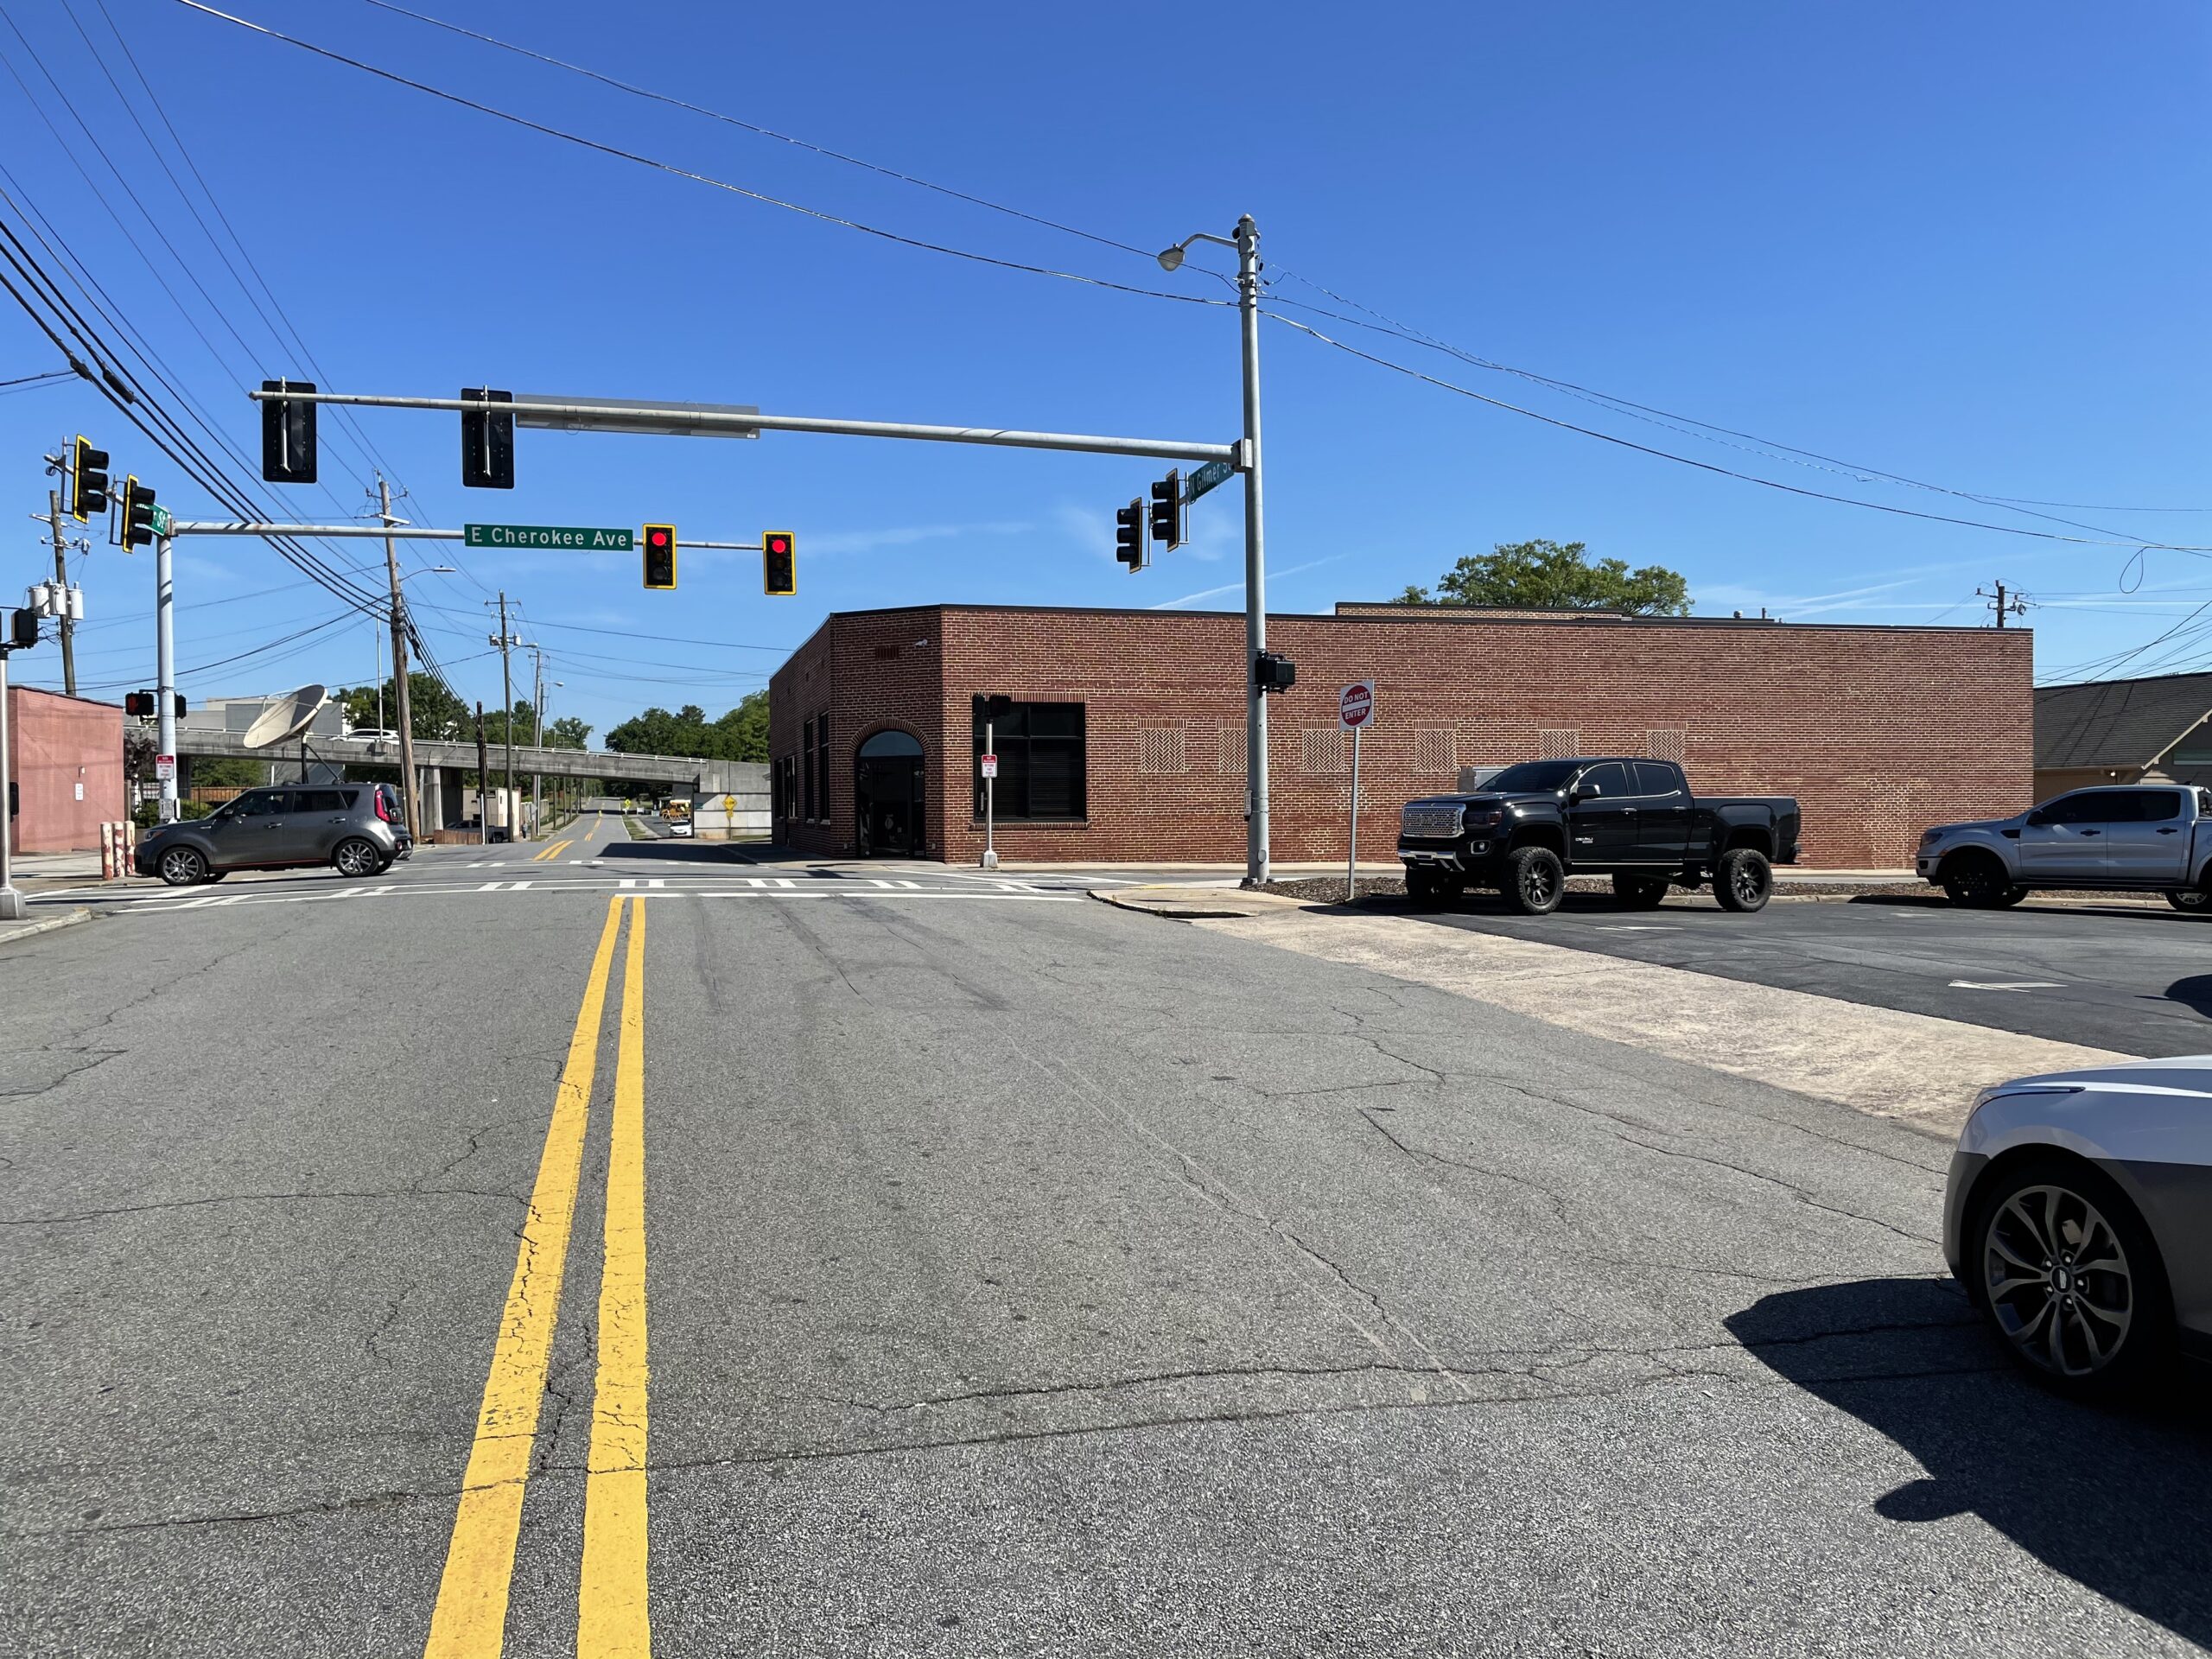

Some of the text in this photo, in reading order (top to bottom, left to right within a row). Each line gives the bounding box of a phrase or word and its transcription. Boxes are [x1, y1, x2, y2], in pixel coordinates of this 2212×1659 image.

[1197, 463, 1220, 492] Gilmer
[157, 511, 166, 529] St
[471, 526, 627, 546] E Cherokee Ave
[1344, 691, 1368, 704] DO NOT
[1344, 709, 1366, 720] ENTER
